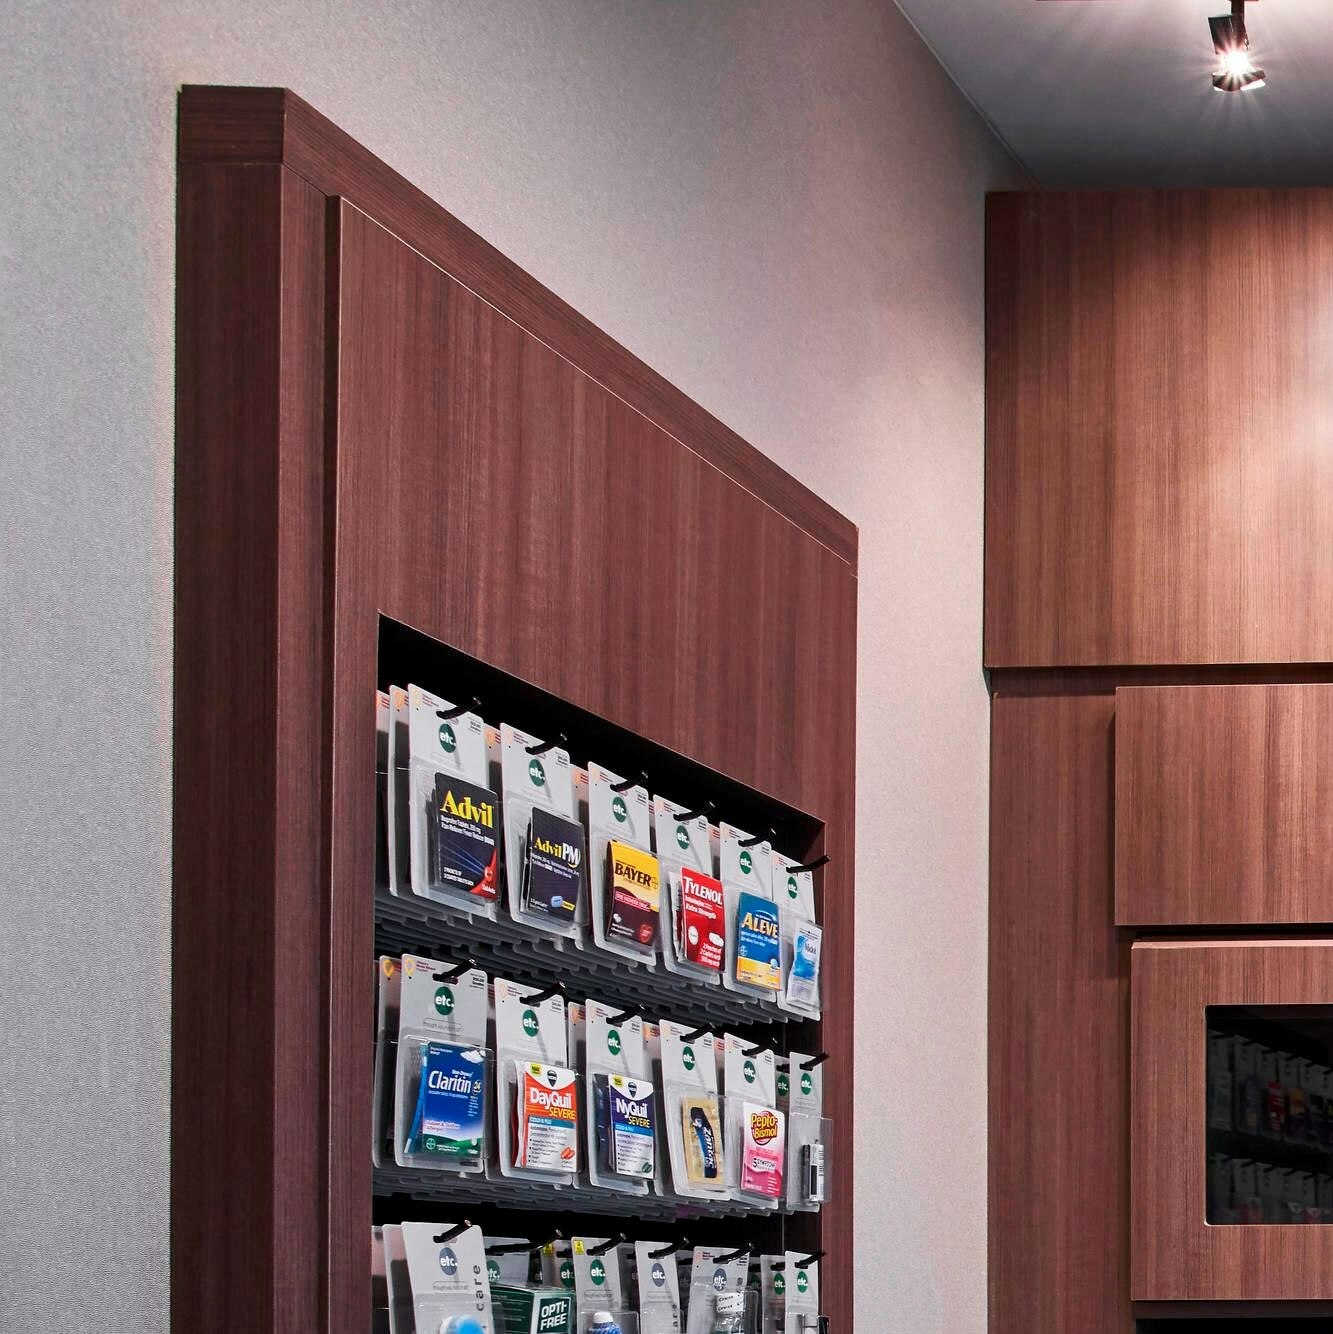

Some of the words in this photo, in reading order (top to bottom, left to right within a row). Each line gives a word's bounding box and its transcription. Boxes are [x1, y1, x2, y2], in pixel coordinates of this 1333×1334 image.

[439, 731, 457, 746] etc.
[529, 766, 546, 781] etc.
[440, 790, 494, 829] Advil
[612, 803, 627, 817] etc.
[676, 831, 691, 844] etc.
[534, 836, 563, 858] Advil
[615, 861, 652, 887] BAYER
[683, 875, 723, 906] TYLENOL
[742, 911, 778, 939] ALEVE
[435, 994, 455, 1008] etc.
[523, 1017, 539, 1030] etc.
[428, 1070, 471, 1094] Claritin
[530, 1087, 573, 1110] DayQuil
[549, 1107, 576, 1120] SEVERE
[616, 1098, 649, 1119] NyQuil
[628, 1115, 650, 1127] SEVERE
[751, 1111, 778, 1129] Pepto-
[754, 1125, 778, 1140] Bismol
[704, 1126, 717, 1170] Zantac
[440, 1256, 458, 1267] etc.
[591, 1268, 606, 1277] etc.
[541, 1301, 568, 1318] OPTI-
[540, 1313, 567, 1331] FREE
